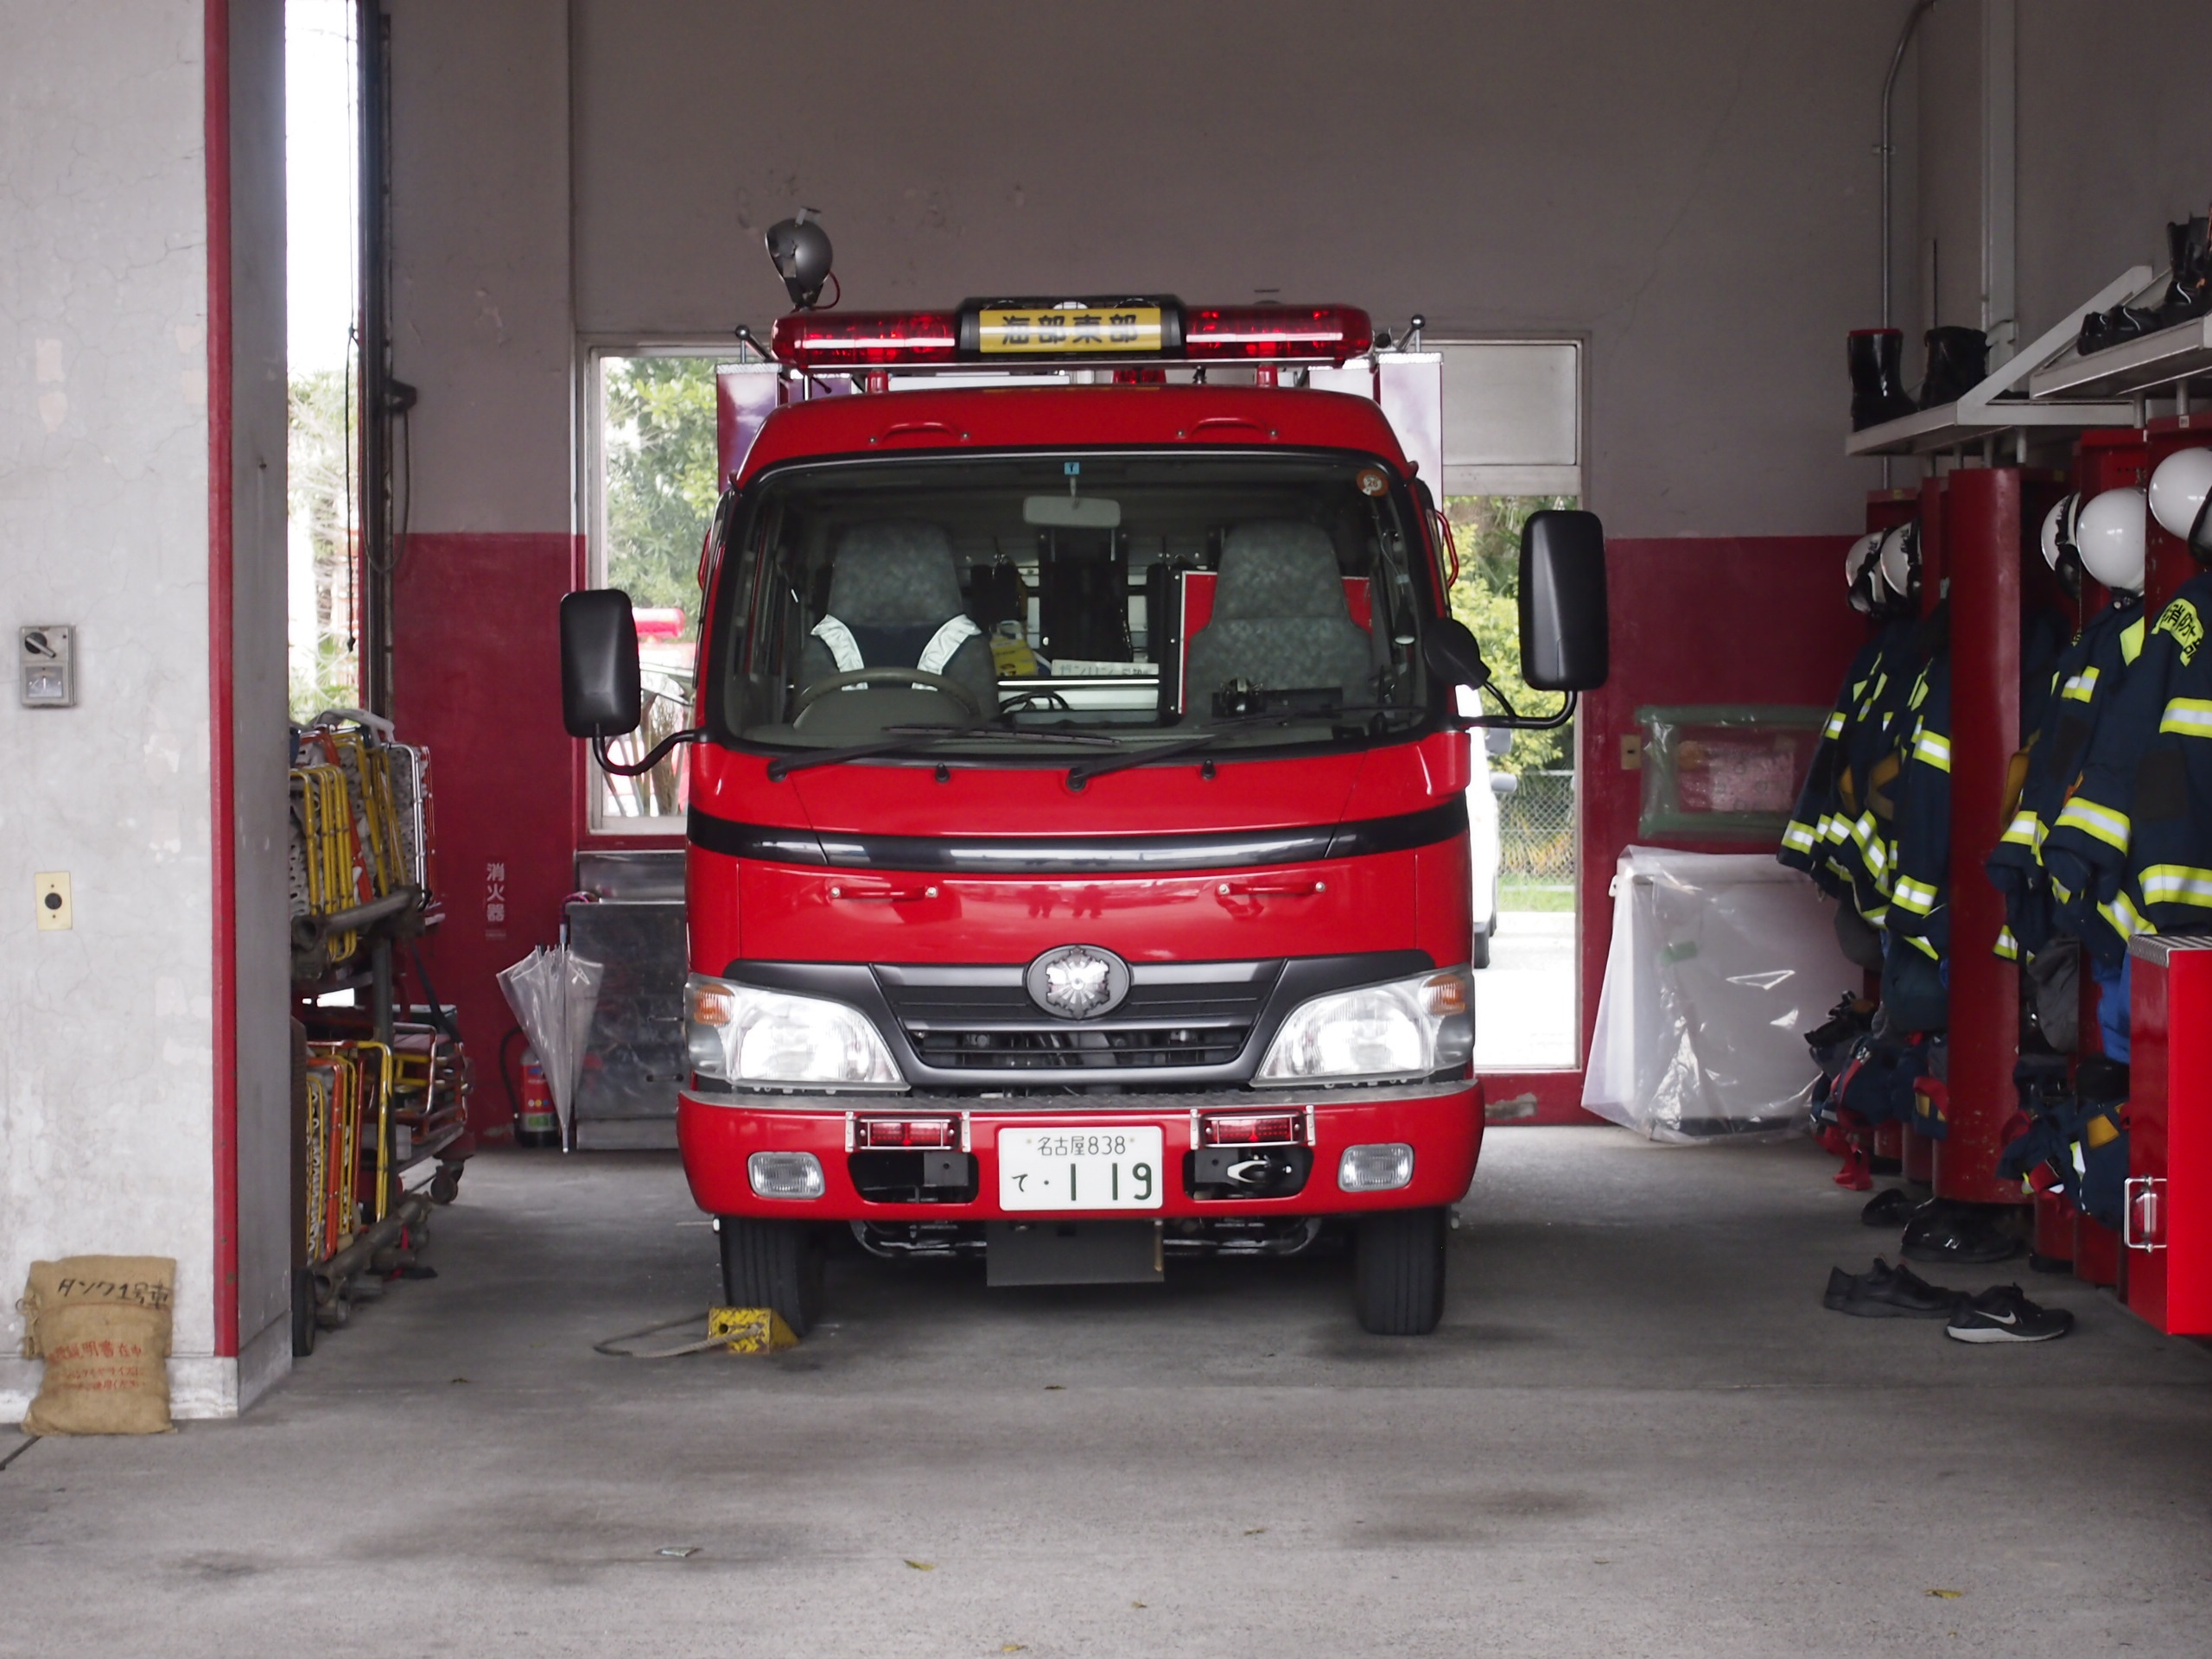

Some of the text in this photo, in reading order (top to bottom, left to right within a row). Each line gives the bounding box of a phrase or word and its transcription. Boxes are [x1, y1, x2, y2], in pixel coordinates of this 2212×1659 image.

[1001, 313, 1139, 345] 海部東部
[486, 862, 505, 922] 消火器
